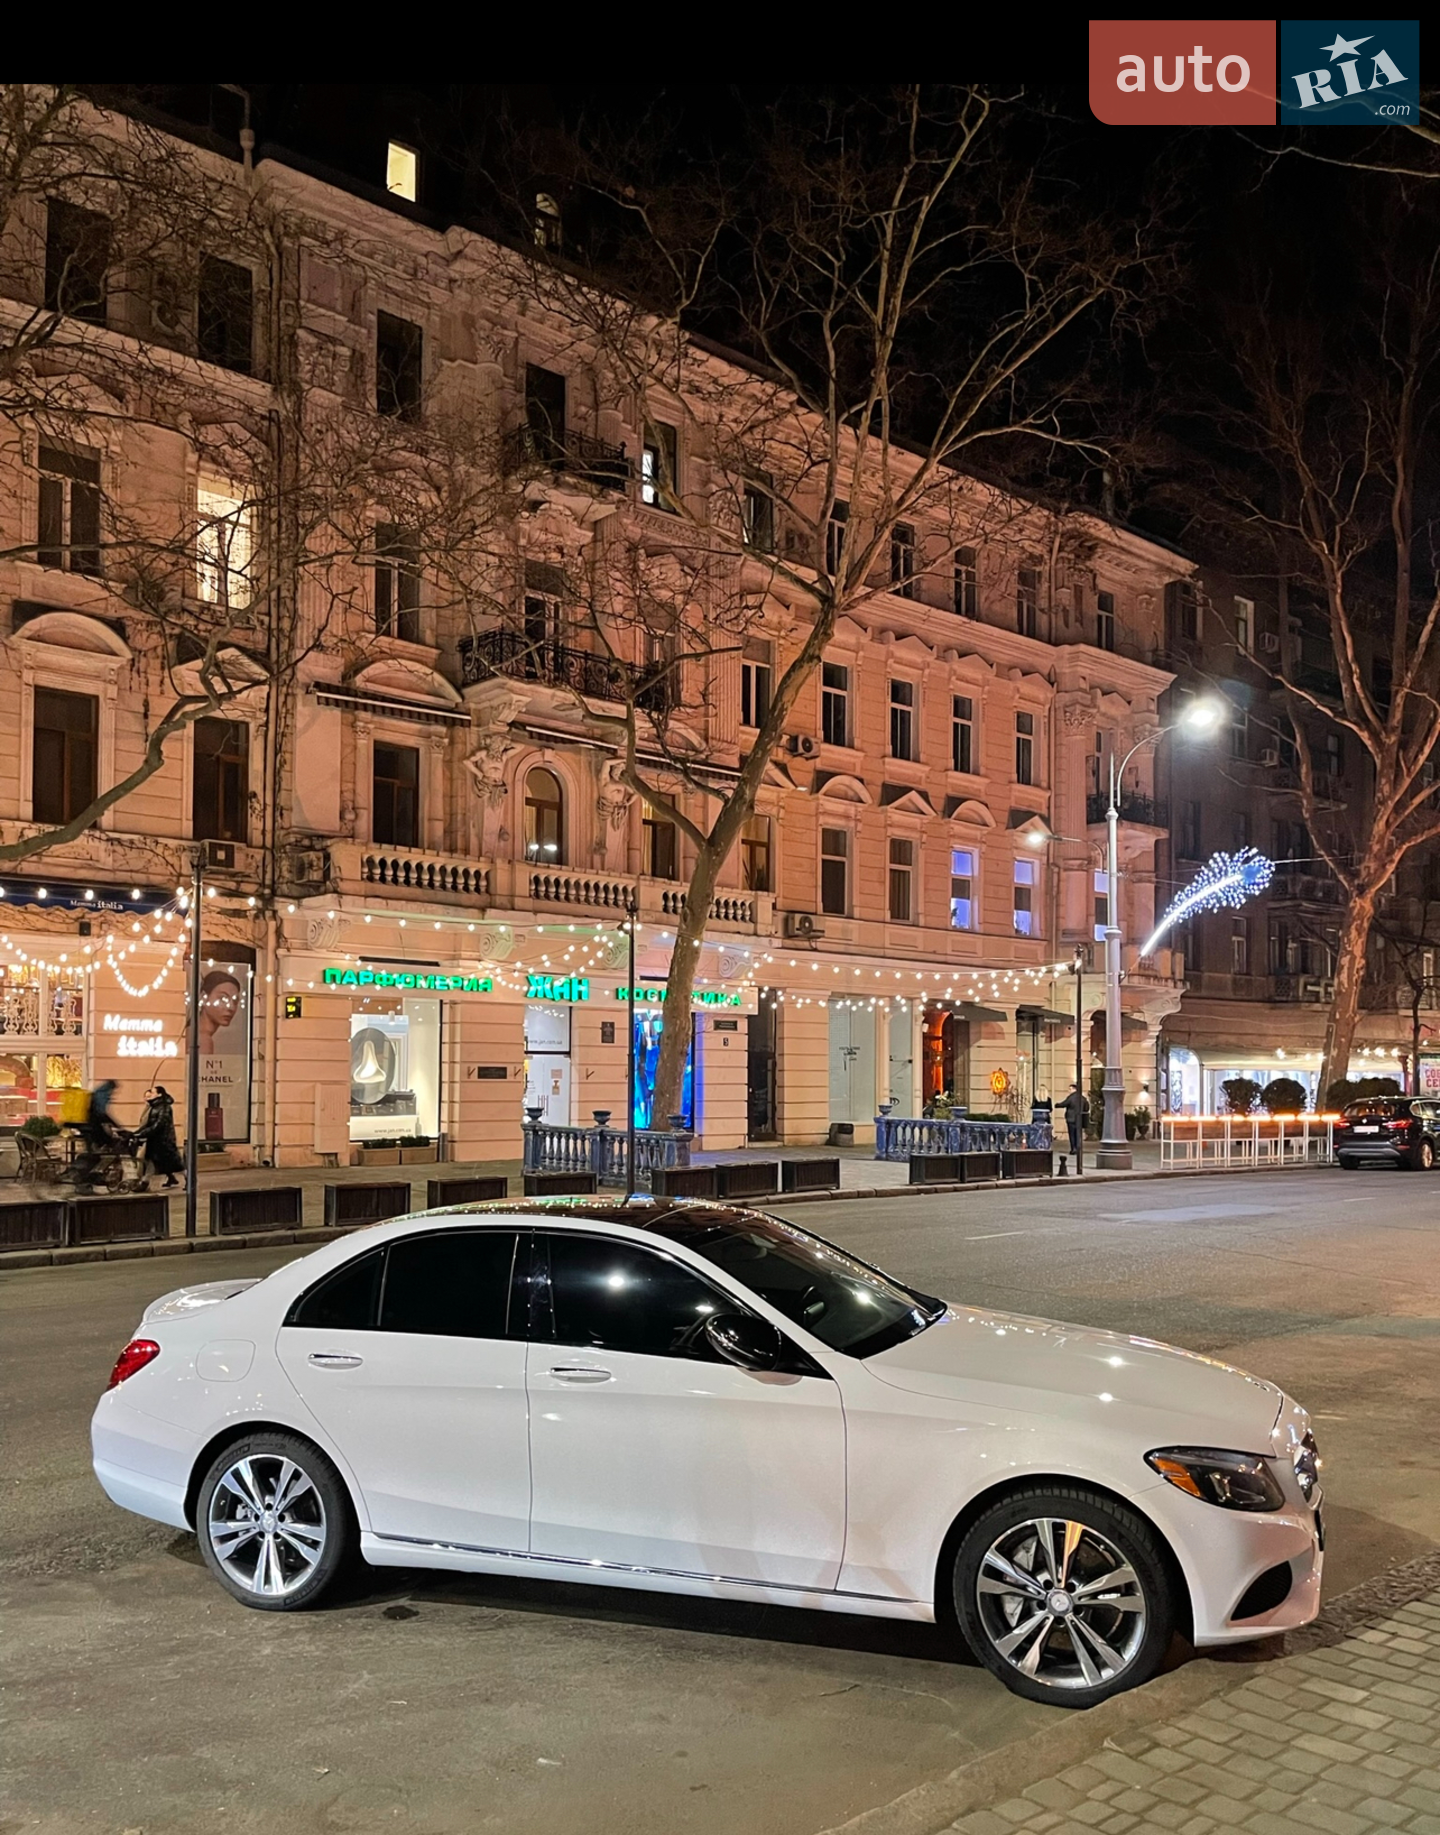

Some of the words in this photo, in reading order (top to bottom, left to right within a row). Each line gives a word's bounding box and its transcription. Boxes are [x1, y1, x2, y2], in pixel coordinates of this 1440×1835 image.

[324, 967, 494, 993] ПАРФЮМЕРИЯ
[525, 974, 590, 1003] ЖАН
[615, 986, 742, 1006] КОСТИКА
[103, 1013, 163, 1033] Mamma
[199, 1075, 234, 1084] HANEL
